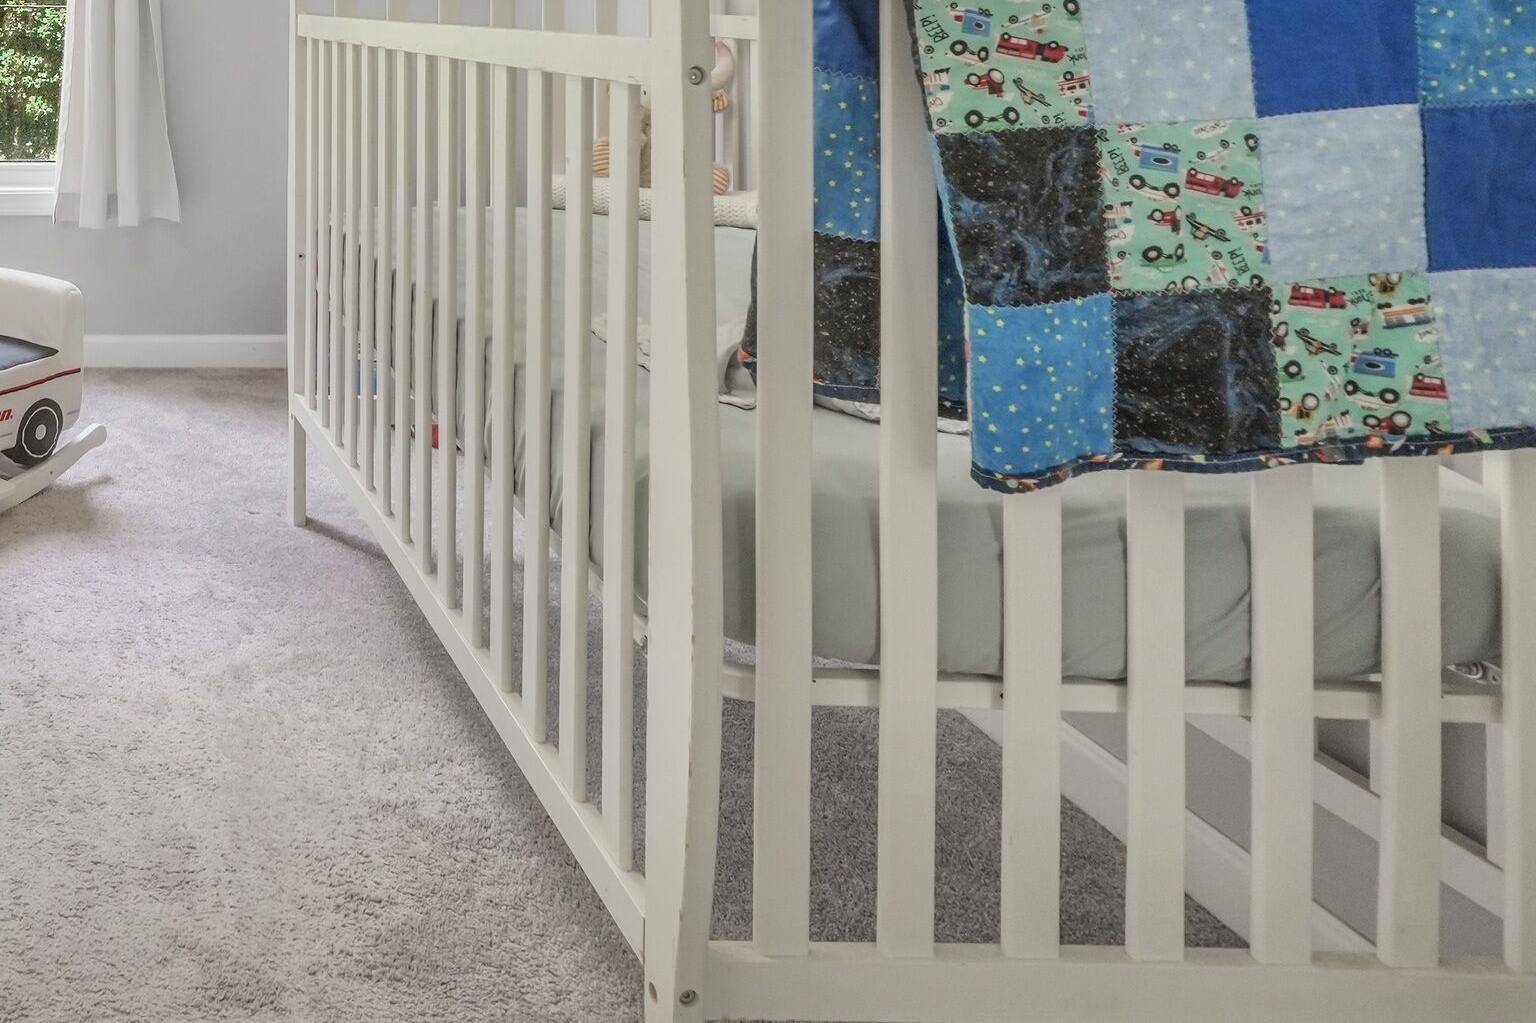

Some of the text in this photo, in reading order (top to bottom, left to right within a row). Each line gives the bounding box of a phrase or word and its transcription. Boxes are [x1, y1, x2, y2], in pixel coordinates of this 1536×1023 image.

[920, 14, 950, 43] BEEP!
[1107, 146, 1130, 176] BEEP!
[1227, 247, 1250, 276] BEEP!
